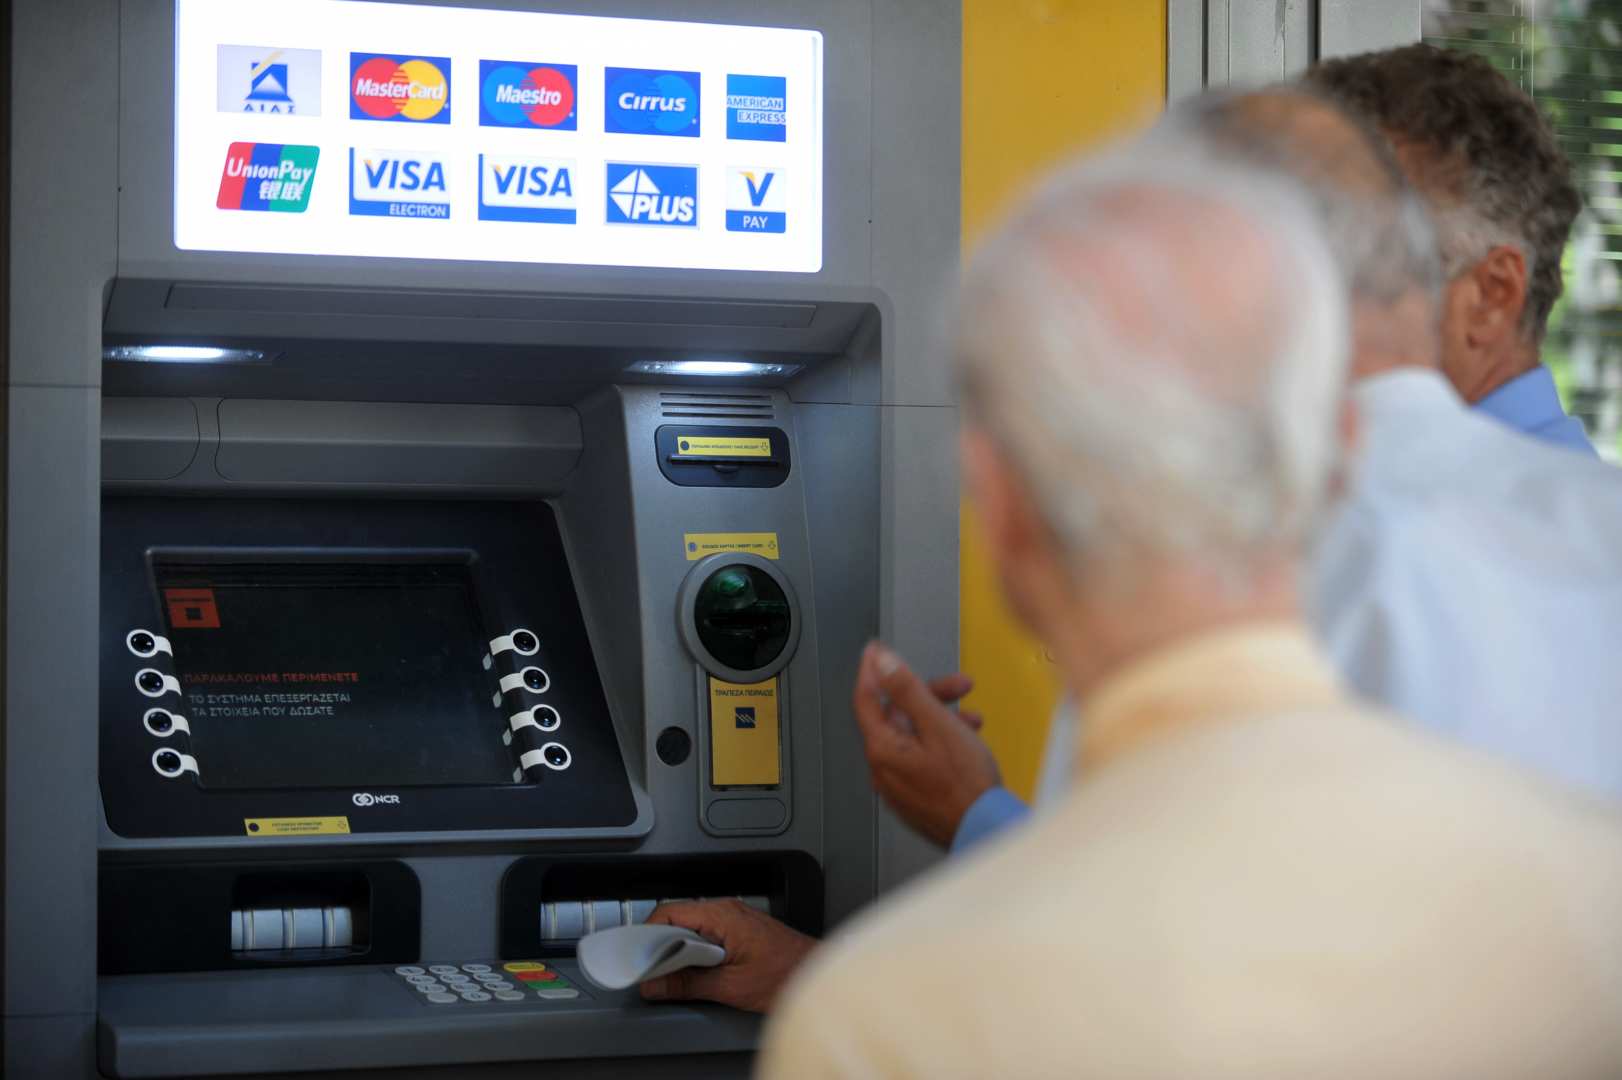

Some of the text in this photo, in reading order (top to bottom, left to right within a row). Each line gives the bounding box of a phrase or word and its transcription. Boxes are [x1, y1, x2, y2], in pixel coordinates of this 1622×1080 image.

[355, 78, 444, 99] MasterCard
[495, 84, 562, 106] Maestro
[618, 92, 686, 112] Cirrus
[727, 97, 783, 108] AMERICAN
[738, 111, 786, 123] EXPRESS
[226, 157, 313, 184] UnionPay
[363, 159, 446, 191] VISA
[491, 165, 572, 197] VISA
[739, 171, 775, 207] V
[389, 203, 447, 217] ELECTRON
[631, 195, 695, 222] PLUS
[743, 215, 768, 229] PAY
[184, 672, 360, 684] ΠΑΡΑΚΑΛΟΥΜΕ ΠΕΡΙΜΕΝΕΤΕ
[189, 693, 351, 704] ΤΟ ΣΥΣΤΗΜΑ ΕΠΕΞΕΡΓΑΖΕΤΑΙ
[191, 706, 335, 717] ΤΑ ΣΤΟΙΧΕΙΑ ΠΟΥ ΔΩΣΑΤΕ
[375, 795, 400, 804] NCR
